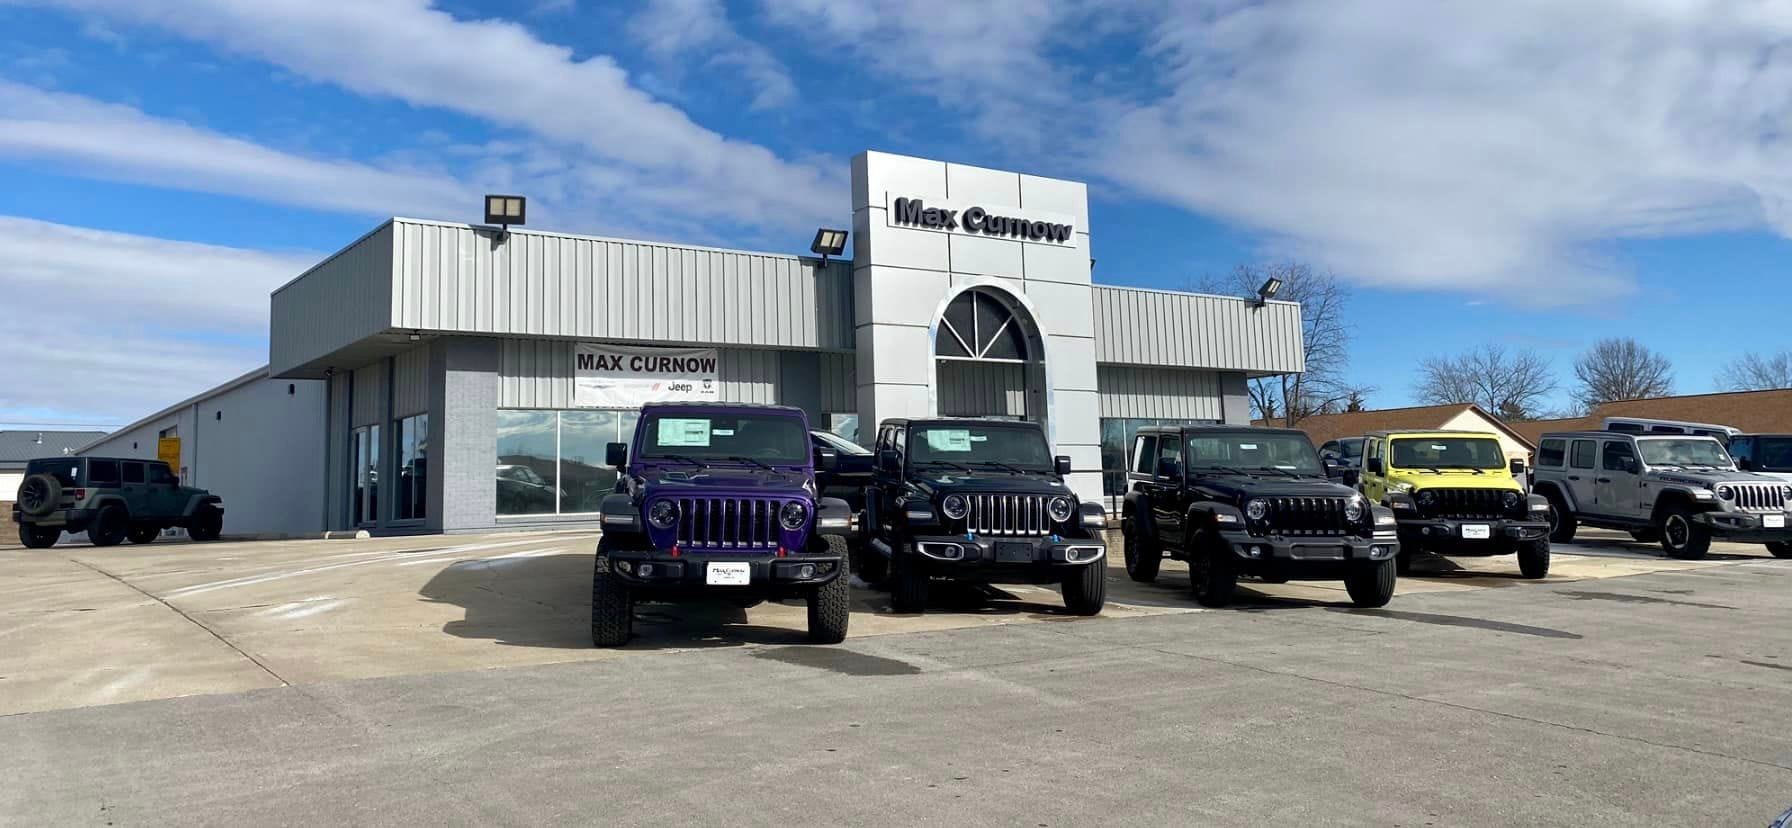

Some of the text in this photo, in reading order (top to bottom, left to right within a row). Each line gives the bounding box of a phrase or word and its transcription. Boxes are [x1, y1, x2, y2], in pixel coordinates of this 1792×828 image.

[894, 197, 1073, 244] Max Curnow
[577, 353, 716, 374] MAX CURNOW
[668, 381, 693, 394] Jeep
